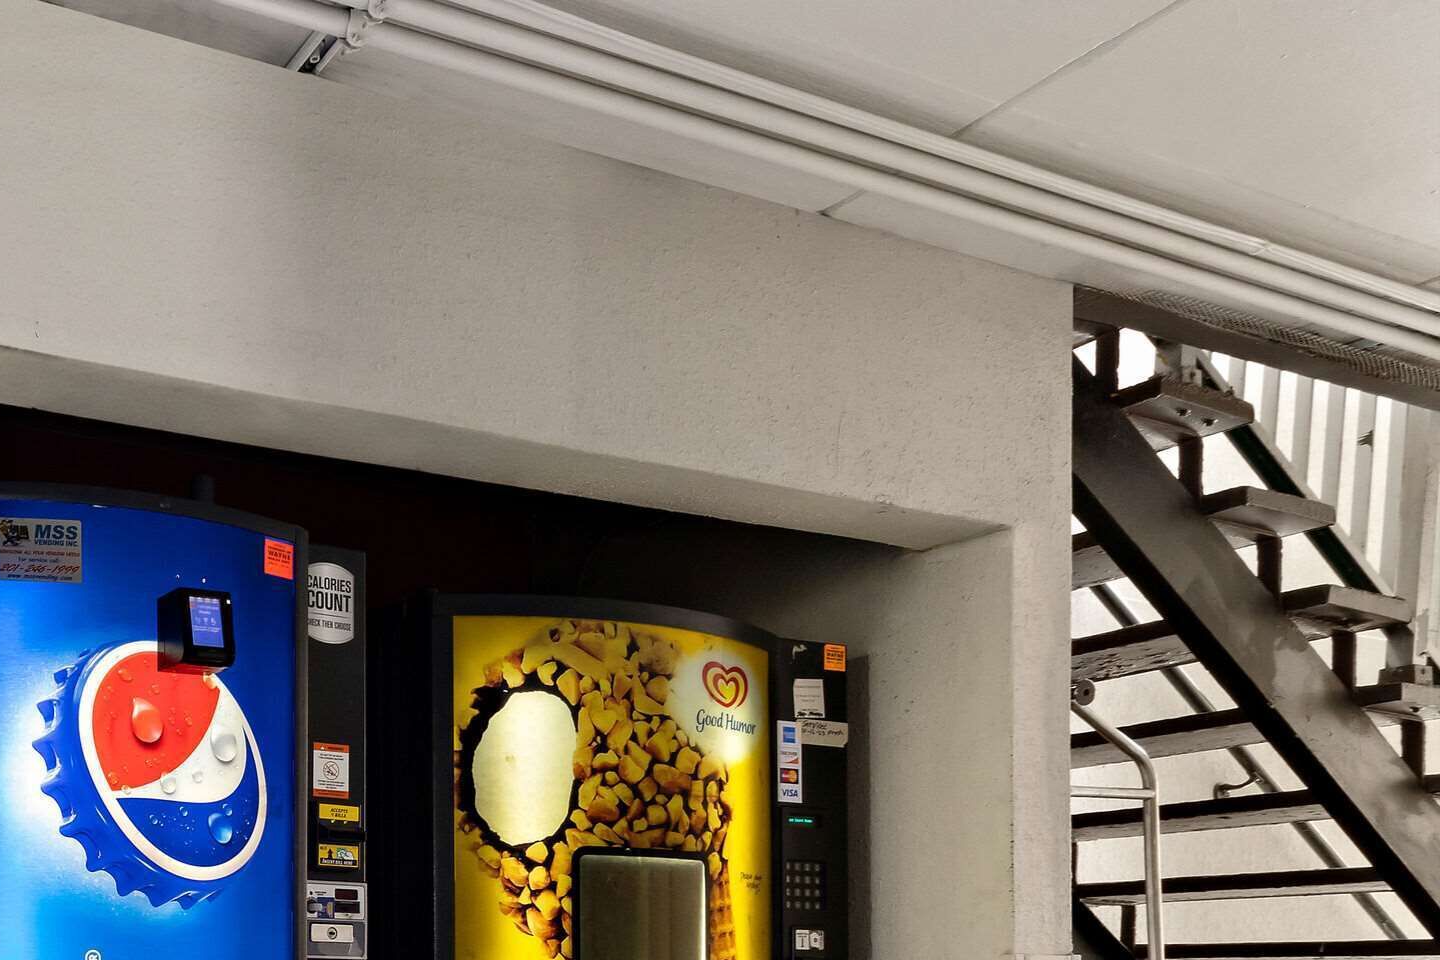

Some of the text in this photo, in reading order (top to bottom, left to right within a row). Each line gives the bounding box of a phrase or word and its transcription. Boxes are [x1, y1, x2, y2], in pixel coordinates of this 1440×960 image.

[35, 525, 78, 540] MSS
[307, 574, 352, 593] CALORIES
[307, 590, 352, 613] COUNT
[696, 708, 756, 735] Good Humor
[783, 788, 798, 797] VISA
